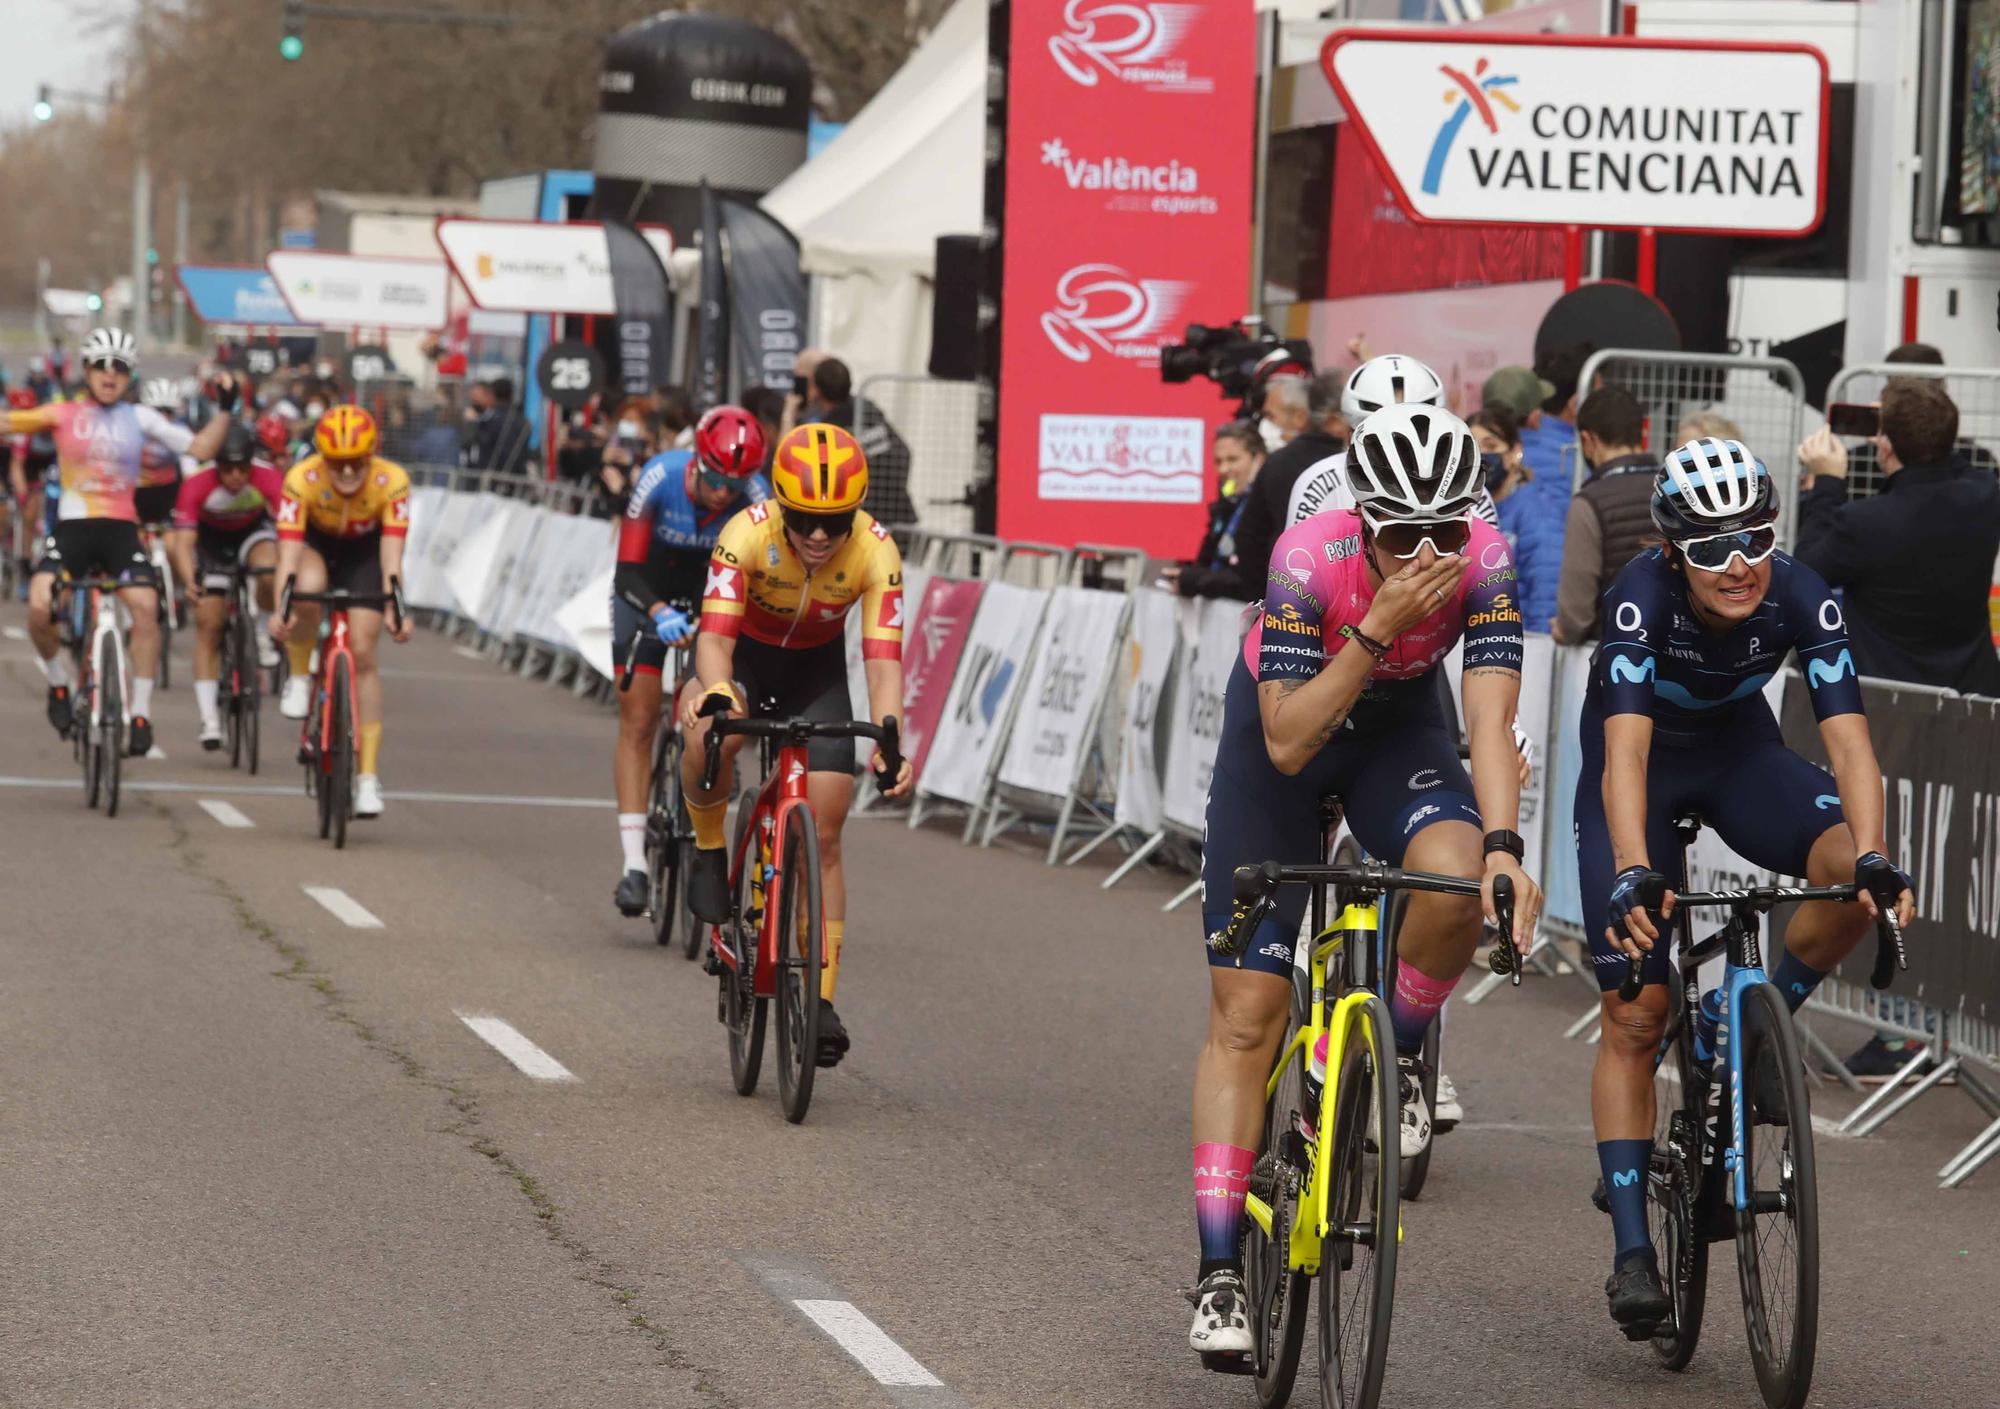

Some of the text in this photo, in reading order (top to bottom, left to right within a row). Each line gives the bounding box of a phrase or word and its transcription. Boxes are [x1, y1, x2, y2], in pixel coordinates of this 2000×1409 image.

[1532, 104, 1803, 145] COMUNITAT
[1063, 156, 1198, 191] València
[1468, 147, 1803, 196] VALENCIANA
[551, 357, 591, 390] 25
[1294, 468, 1342, 524] ERATIZIT
[1324, 533, 1361, 564] PBM
[1265, 614, 1321, 637] Ghidini
